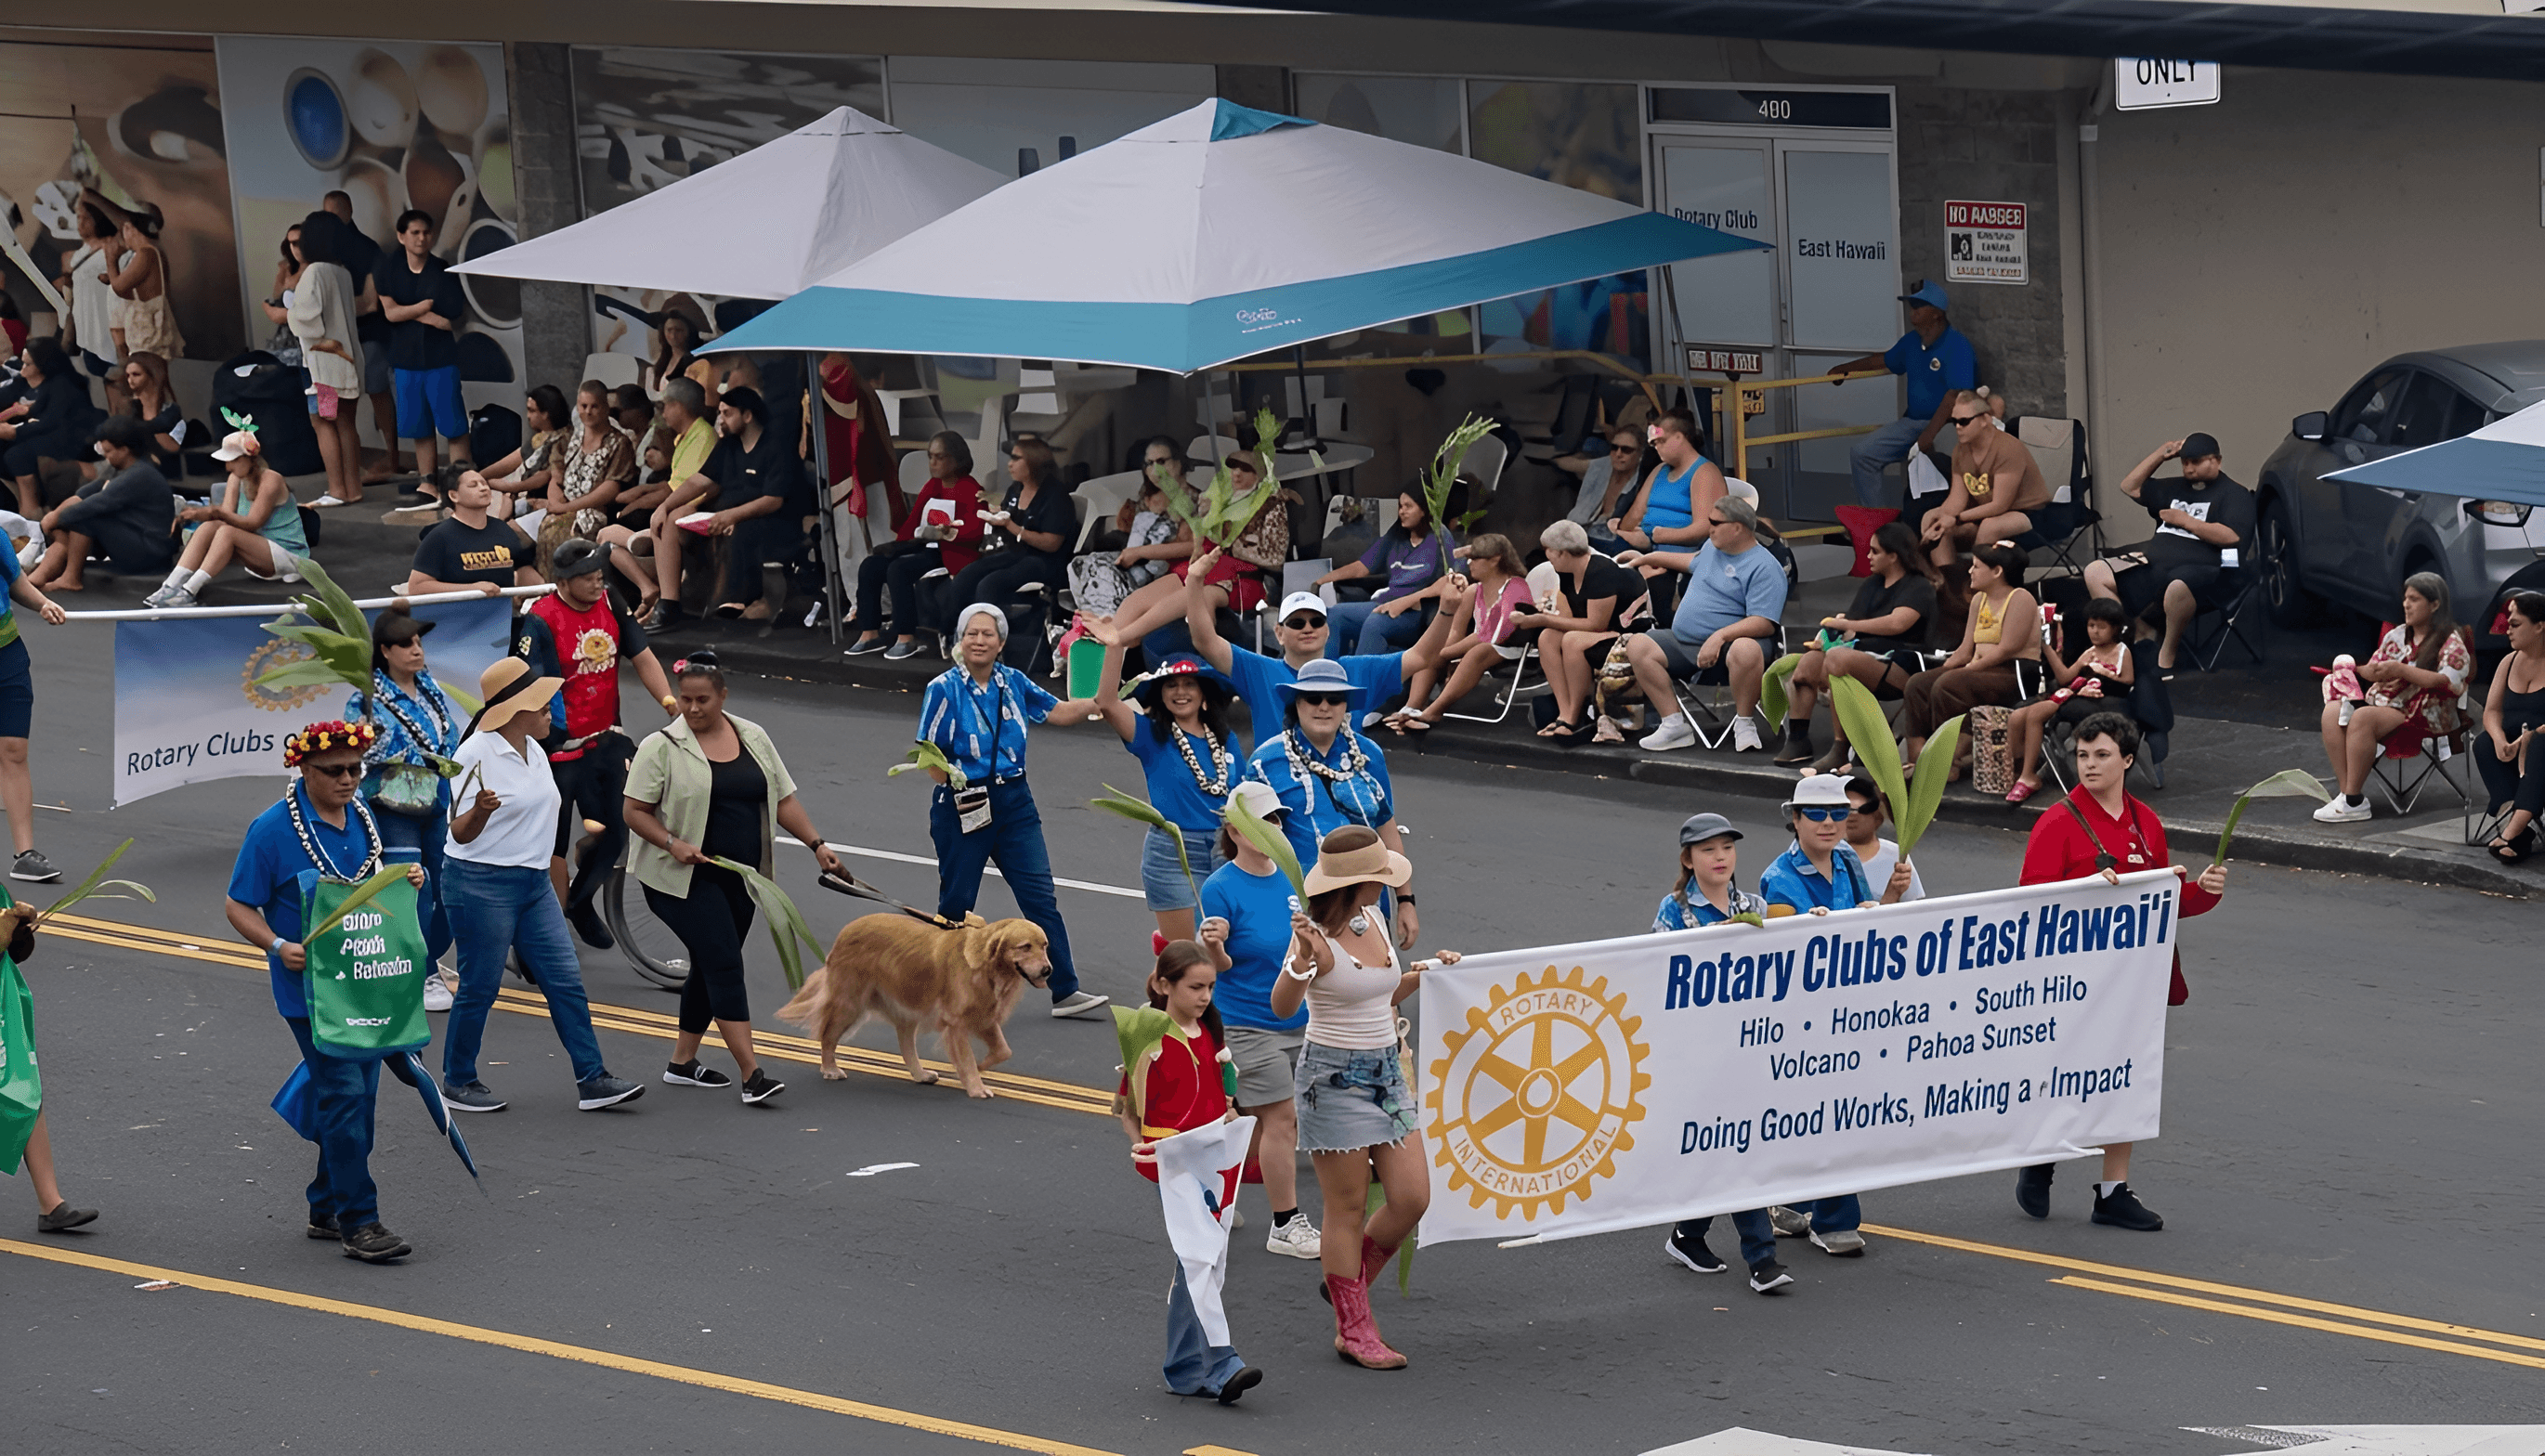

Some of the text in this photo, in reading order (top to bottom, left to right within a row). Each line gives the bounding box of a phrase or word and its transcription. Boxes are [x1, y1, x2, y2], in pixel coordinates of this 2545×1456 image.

[2137, 58, 2195, 85] ONLY
[1725, 209, 1758, 229] Club
[1798, 238, 1831, 258] East
[127, 740, 200, 776] Rotary
[206, 728, 275, 757] Clubs
[1664, 949, 1795, 1010] Rotary
[1803, 929, 1908, 993] Clubs
[1916, 918, 1954, 977] of
[1958, 911, 2030, 971] East
[1500, 992, 1593, 1026] ROTARY
[1740, 975, 2088, 1047] Hilo Honokaa South Hilo
[1769, 1016, 2056, 1081] Volcano Pahoa Sunset
[1680, 1058, 2134, 1155] Doing Good Works, Making a Impact
[1454, 1125, 1617, 1195] INTERNATIONAL
